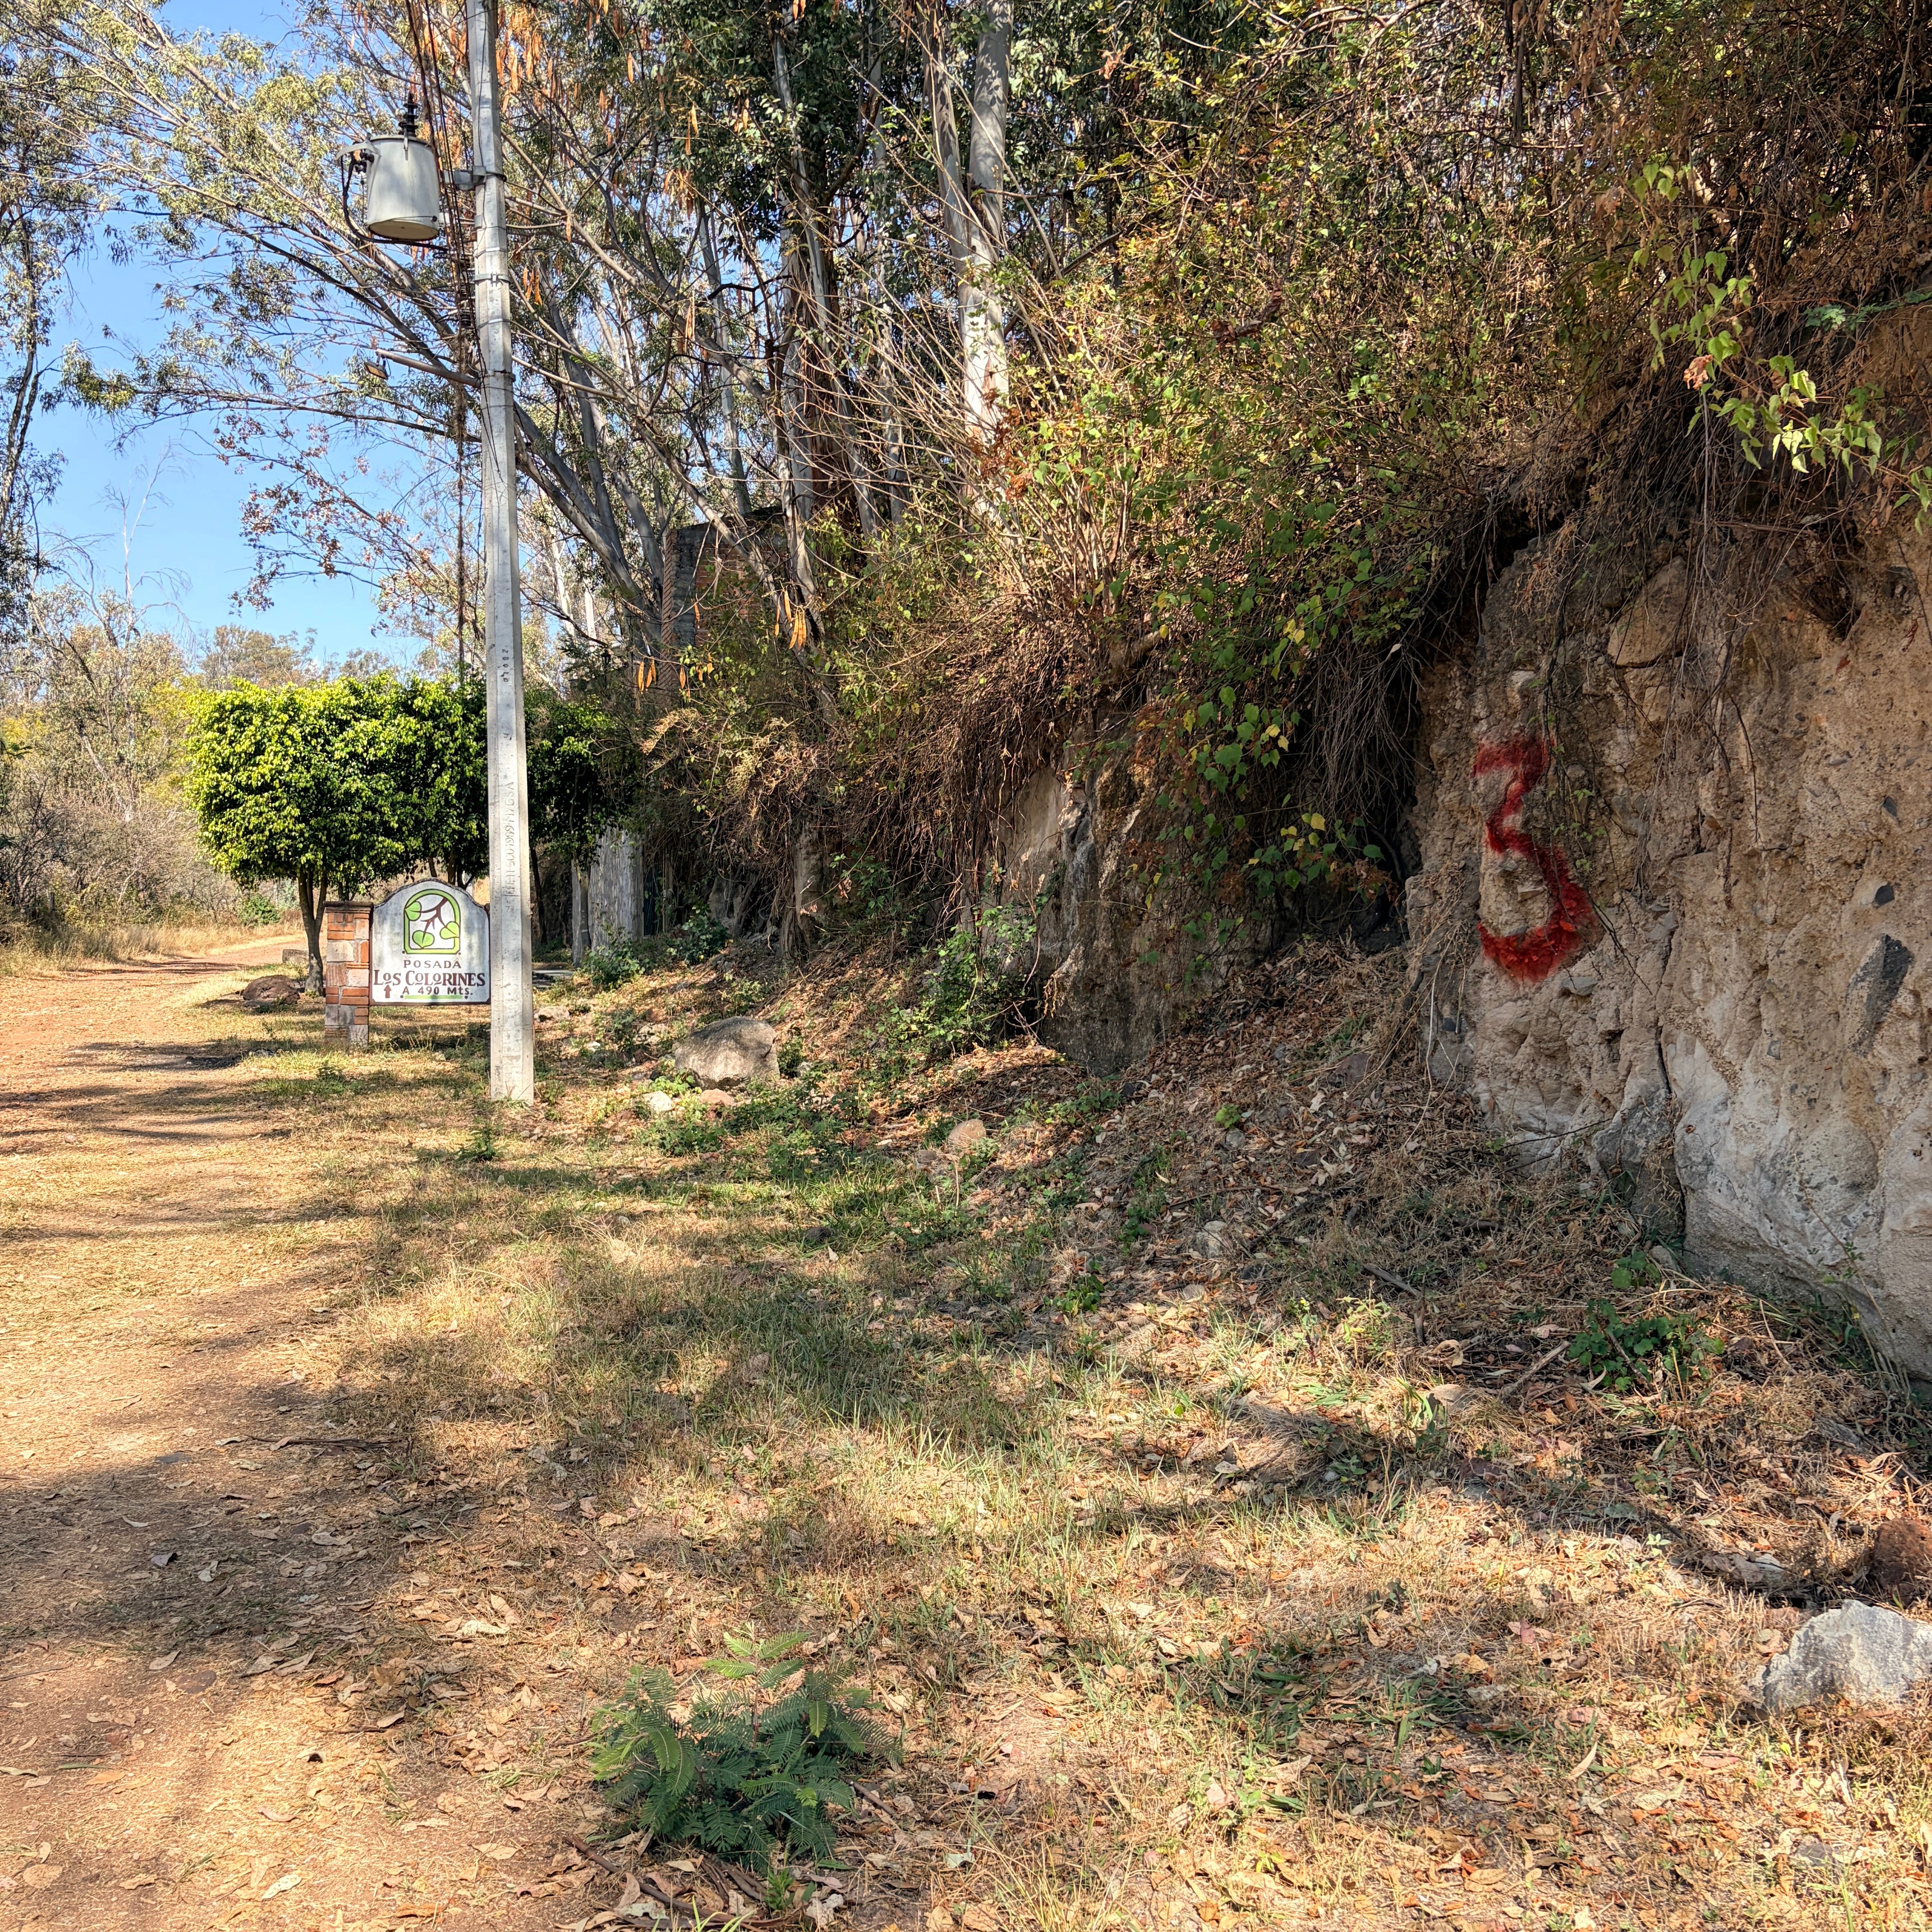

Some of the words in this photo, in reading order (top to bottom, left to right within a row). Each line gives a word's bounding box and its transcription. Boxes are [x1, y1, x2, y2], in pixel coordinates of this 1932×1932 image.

[404, 960, 461, 968] POSADA
[402, 986, 409, 995] A
[418, 986, 439, 995] 490
[447, 986, 473, 995] Mts.
